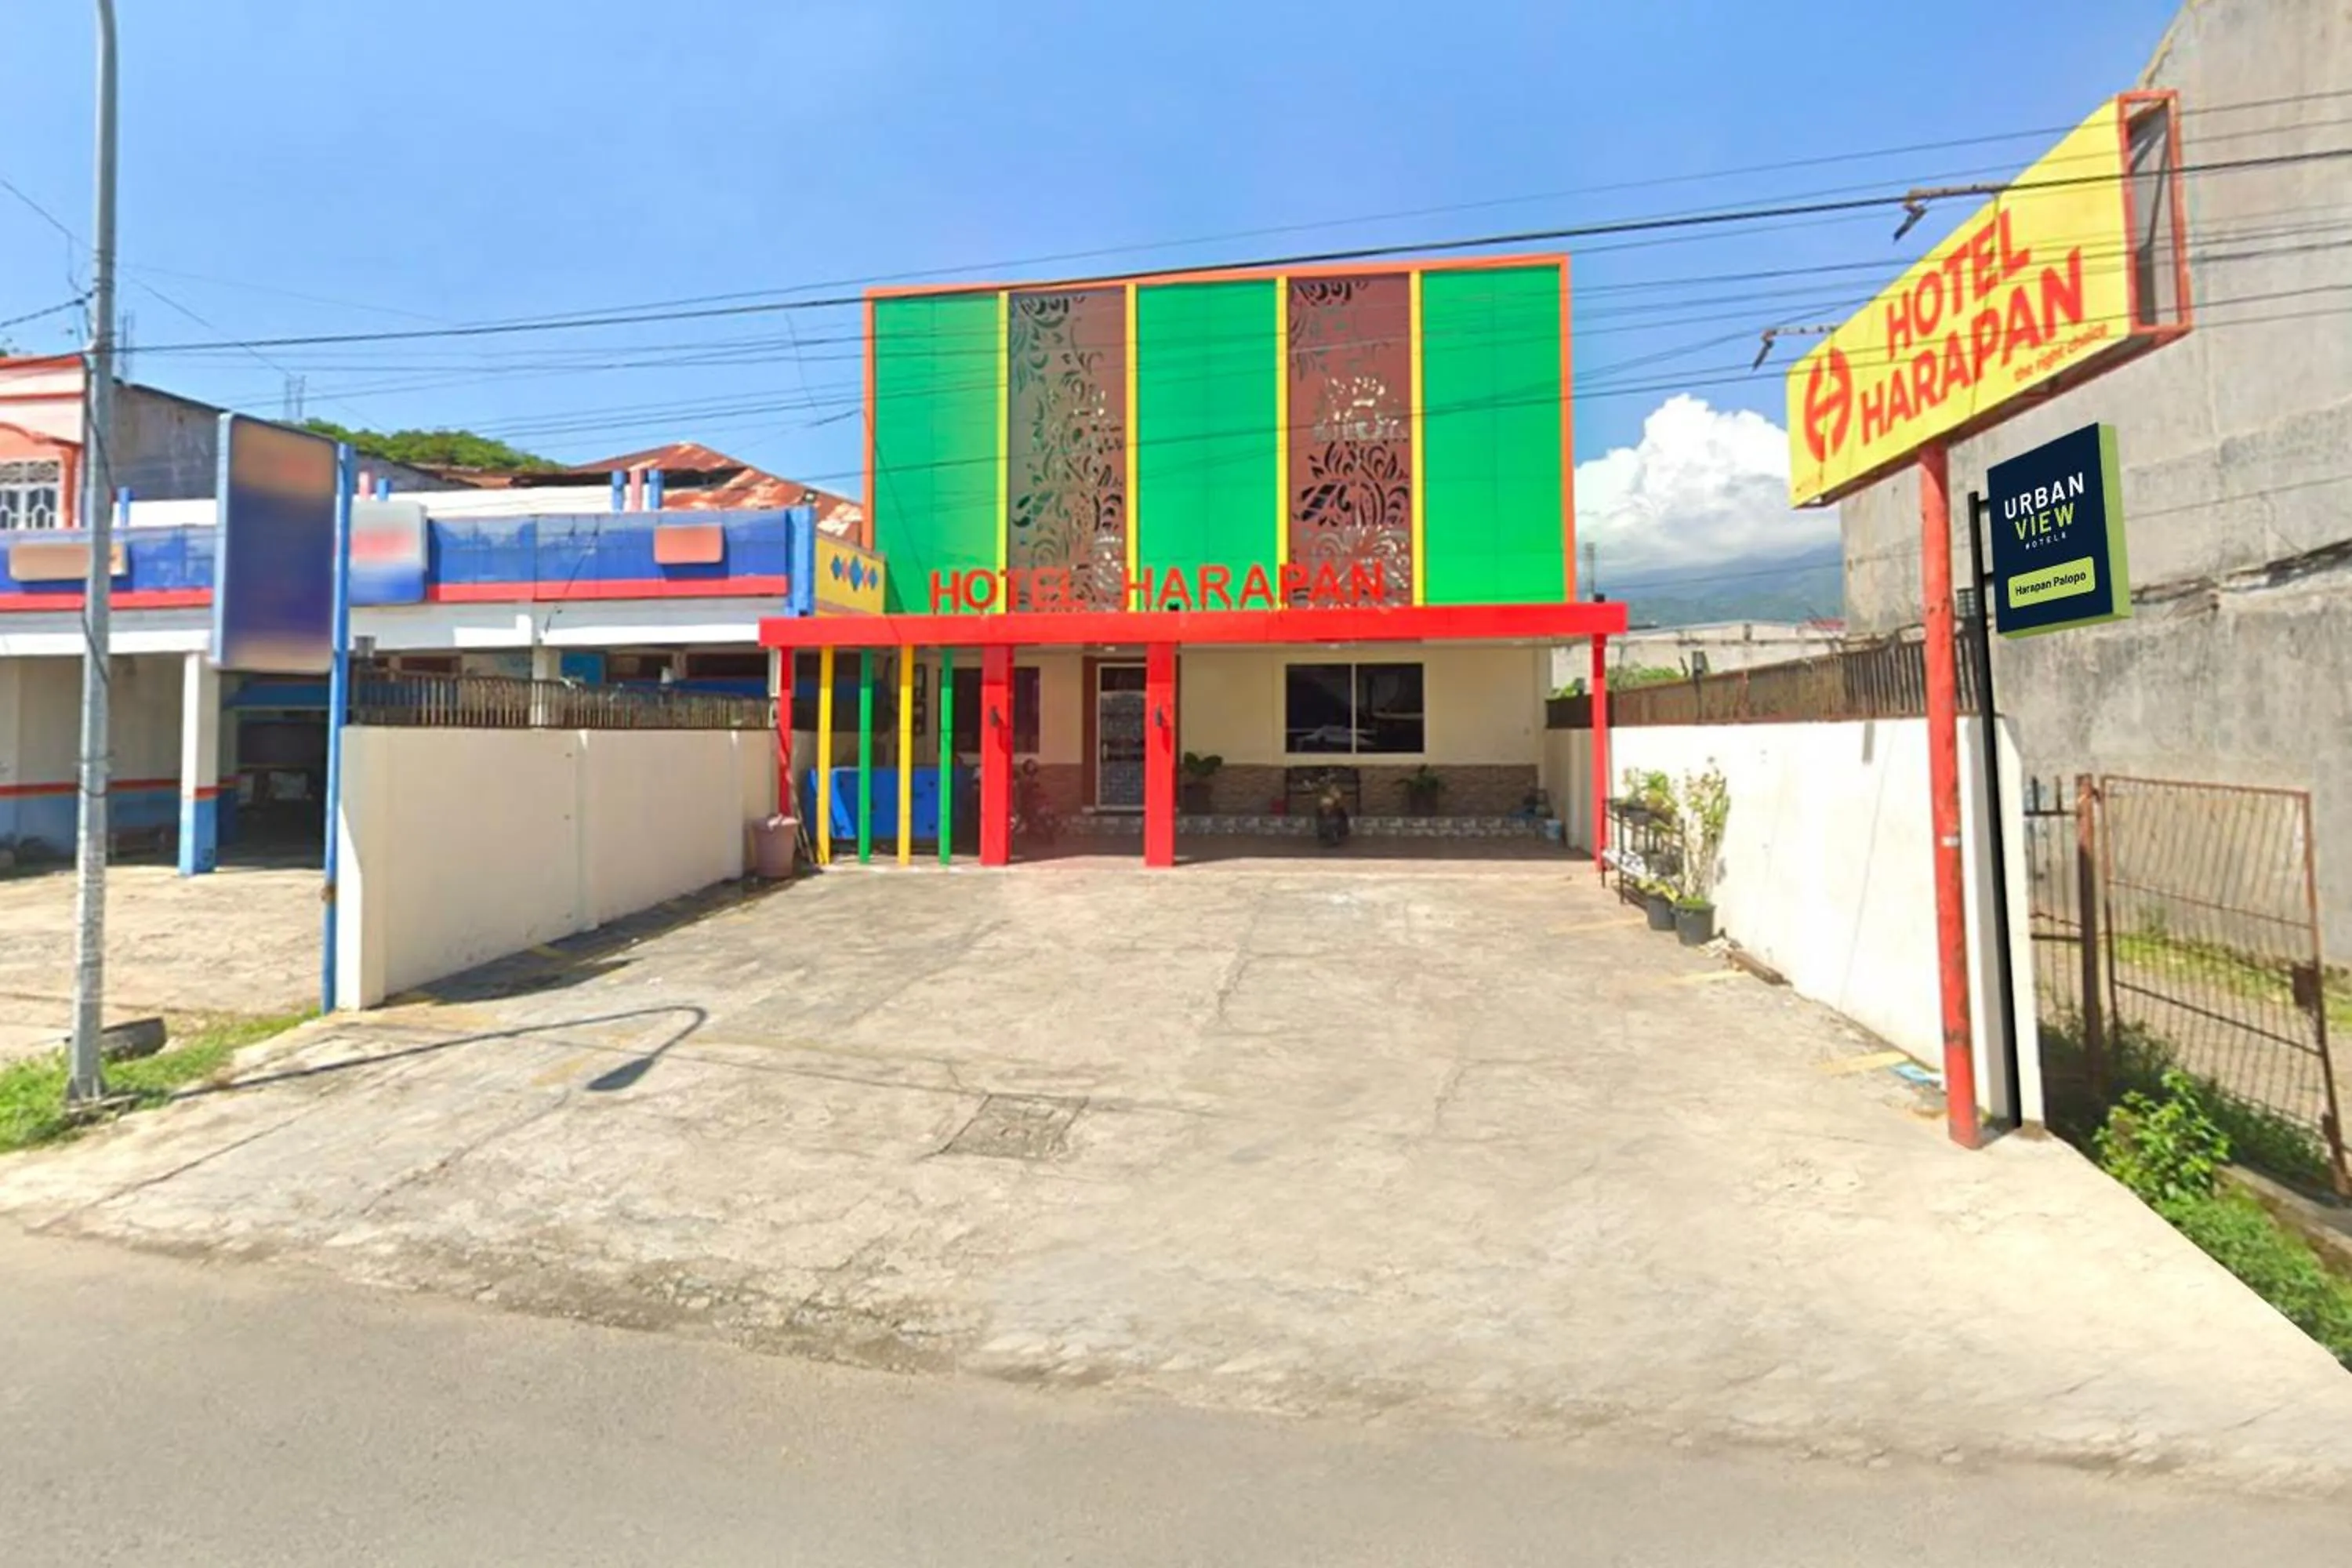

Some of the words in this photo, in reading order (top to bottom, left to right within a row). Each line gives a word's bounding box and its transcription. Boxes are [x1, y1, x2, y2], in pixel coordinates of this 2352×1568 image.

[1886, 208, 2031, 360] HOTEL
[1860, 245, 2083, 445] HARAPAN
[2005, 472, 2085, 519] URBAN
[2014, 502, 2074, 540] VIEW
[930, 566, 1086, 610] HOTEL
[1122, 558, 1385, 610] HARAPAN
[2015, 580, 2052, 596] Harapan
[2053, 572, 2087, 586] Palopo
